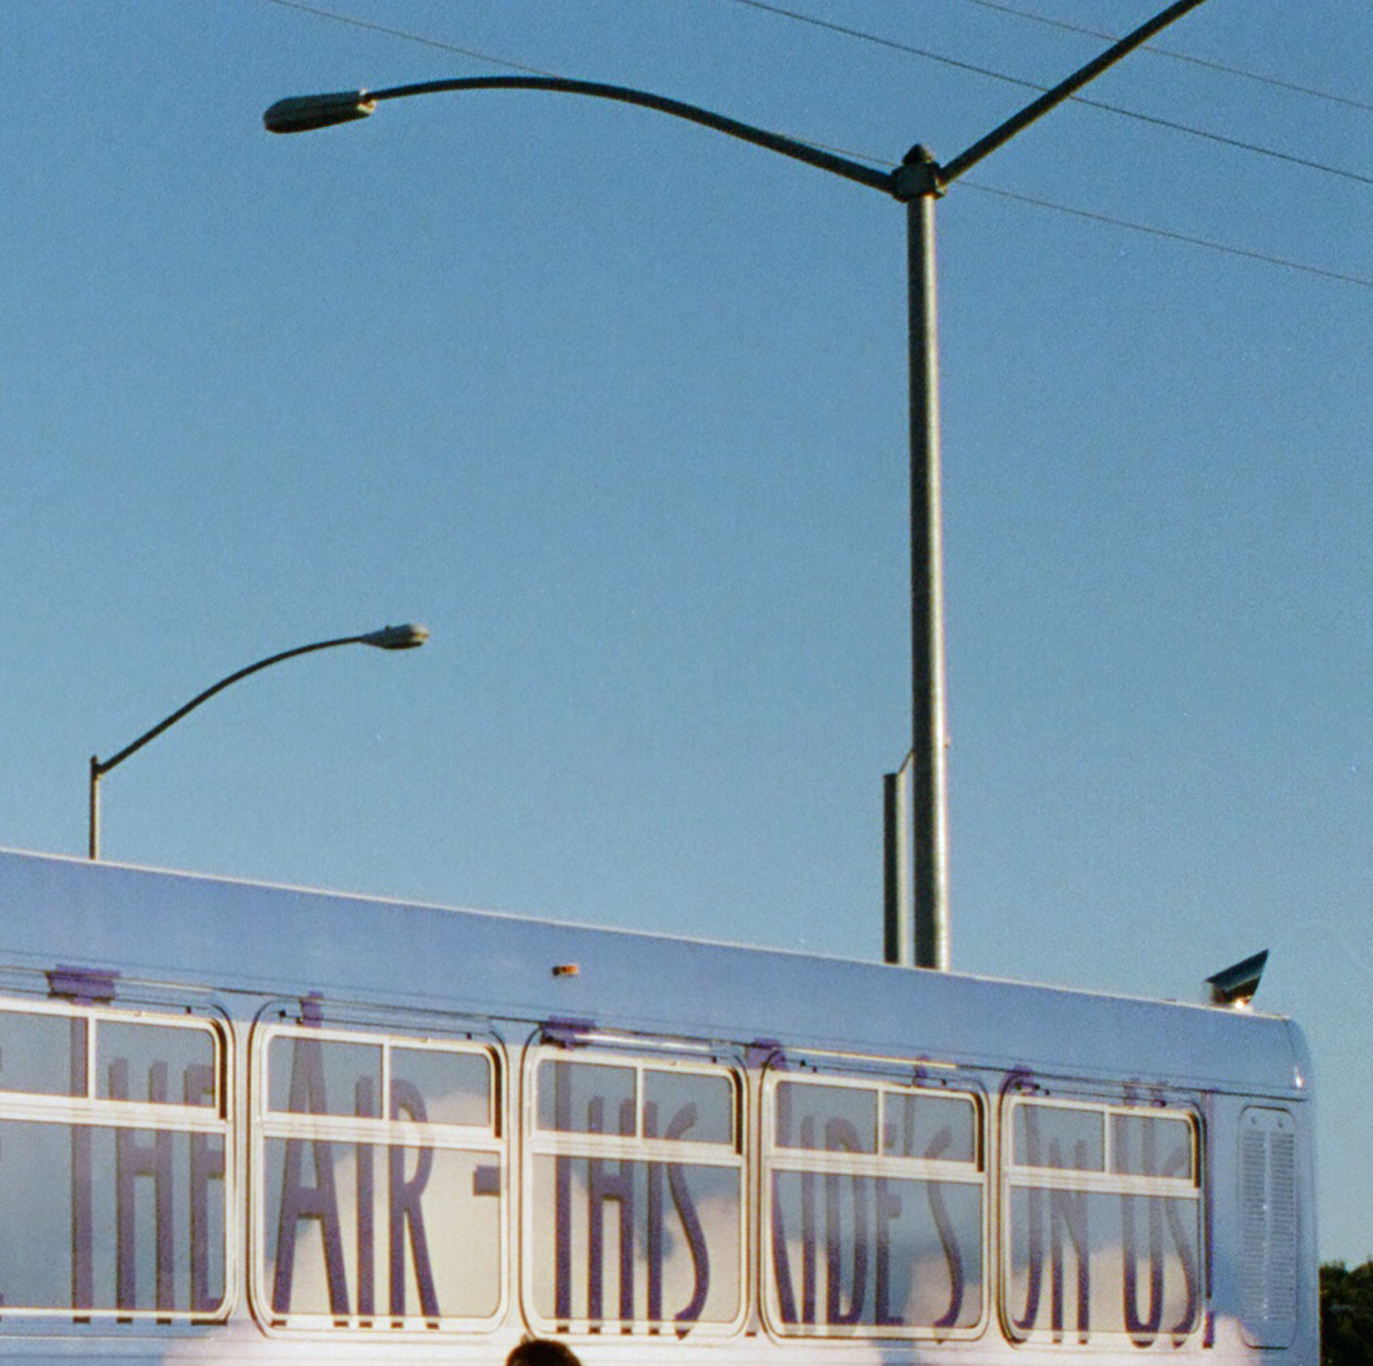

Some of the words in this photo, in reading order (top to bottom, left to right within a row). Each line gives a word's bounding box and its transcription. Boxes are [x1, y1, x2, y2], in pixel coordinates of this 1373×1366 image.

[47, 964, 229, 1326] THE
[268, 991, 442, 1330] AIR
[541, 1014, 711, 1341] THIS
